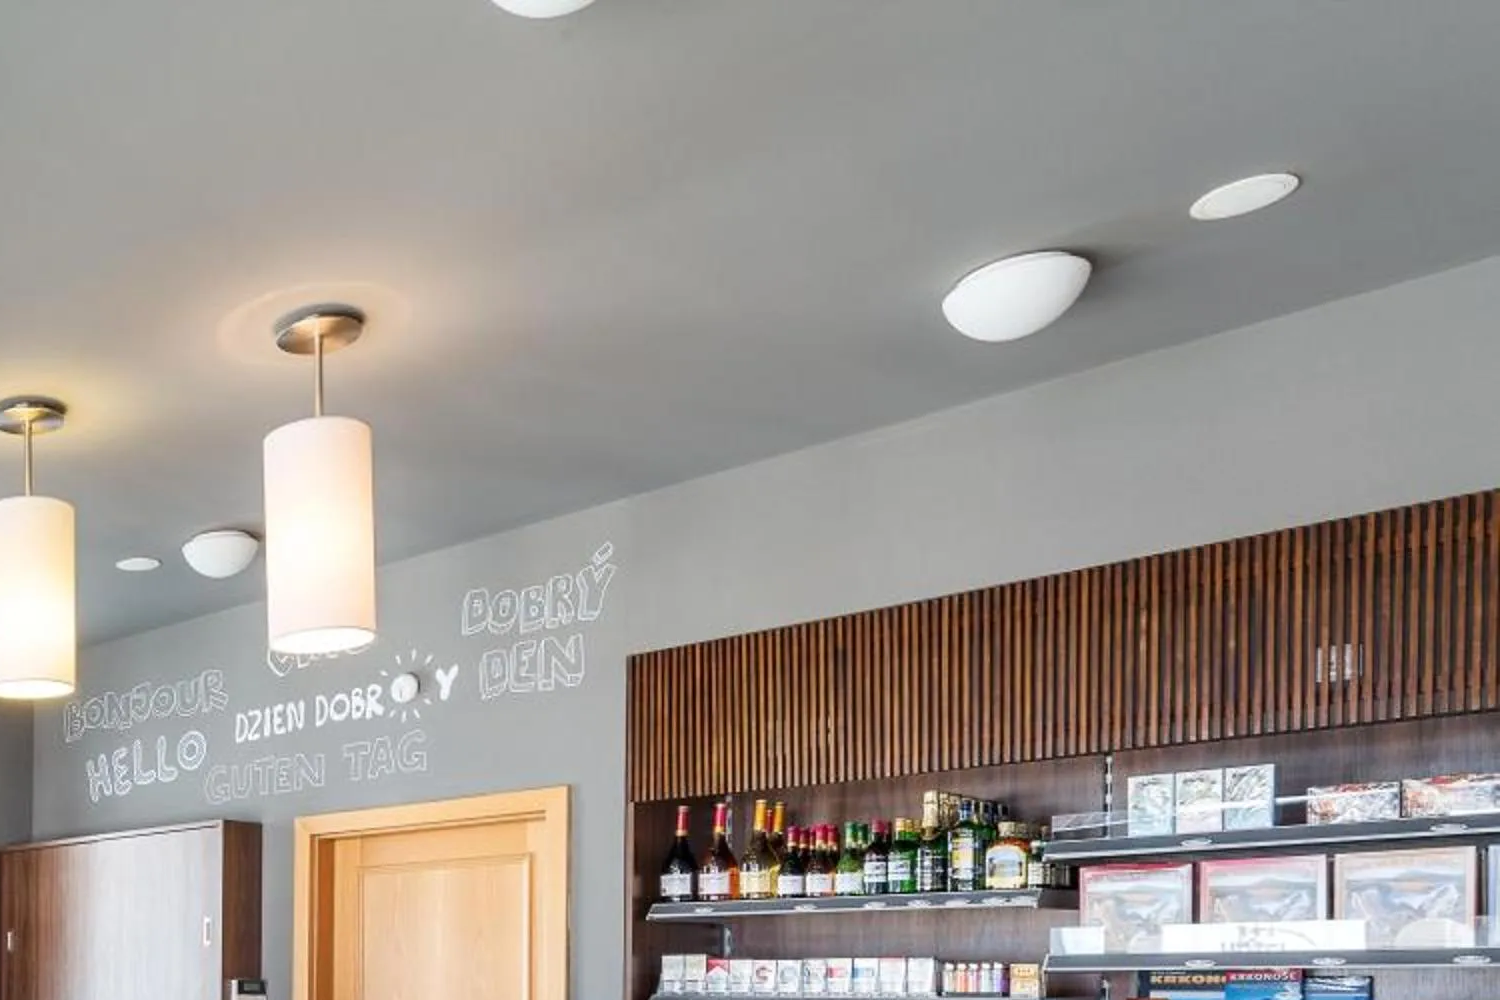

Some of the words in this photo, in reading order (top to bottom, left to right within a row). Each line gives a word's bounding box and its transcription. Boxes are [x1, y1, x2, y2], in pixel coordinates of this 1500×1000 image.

[461, 541, 617, 636] DOBRÝ
[478, 634, 585, 699] DEN
[65, 670, 229, 742] BONJOUR
[235, 700, 304, 743] DZIEN
[86, 730, 208, 802] HELLO
[204, 752, 325, 804] GUTEN
[343, 730, 428, 782] TAG
